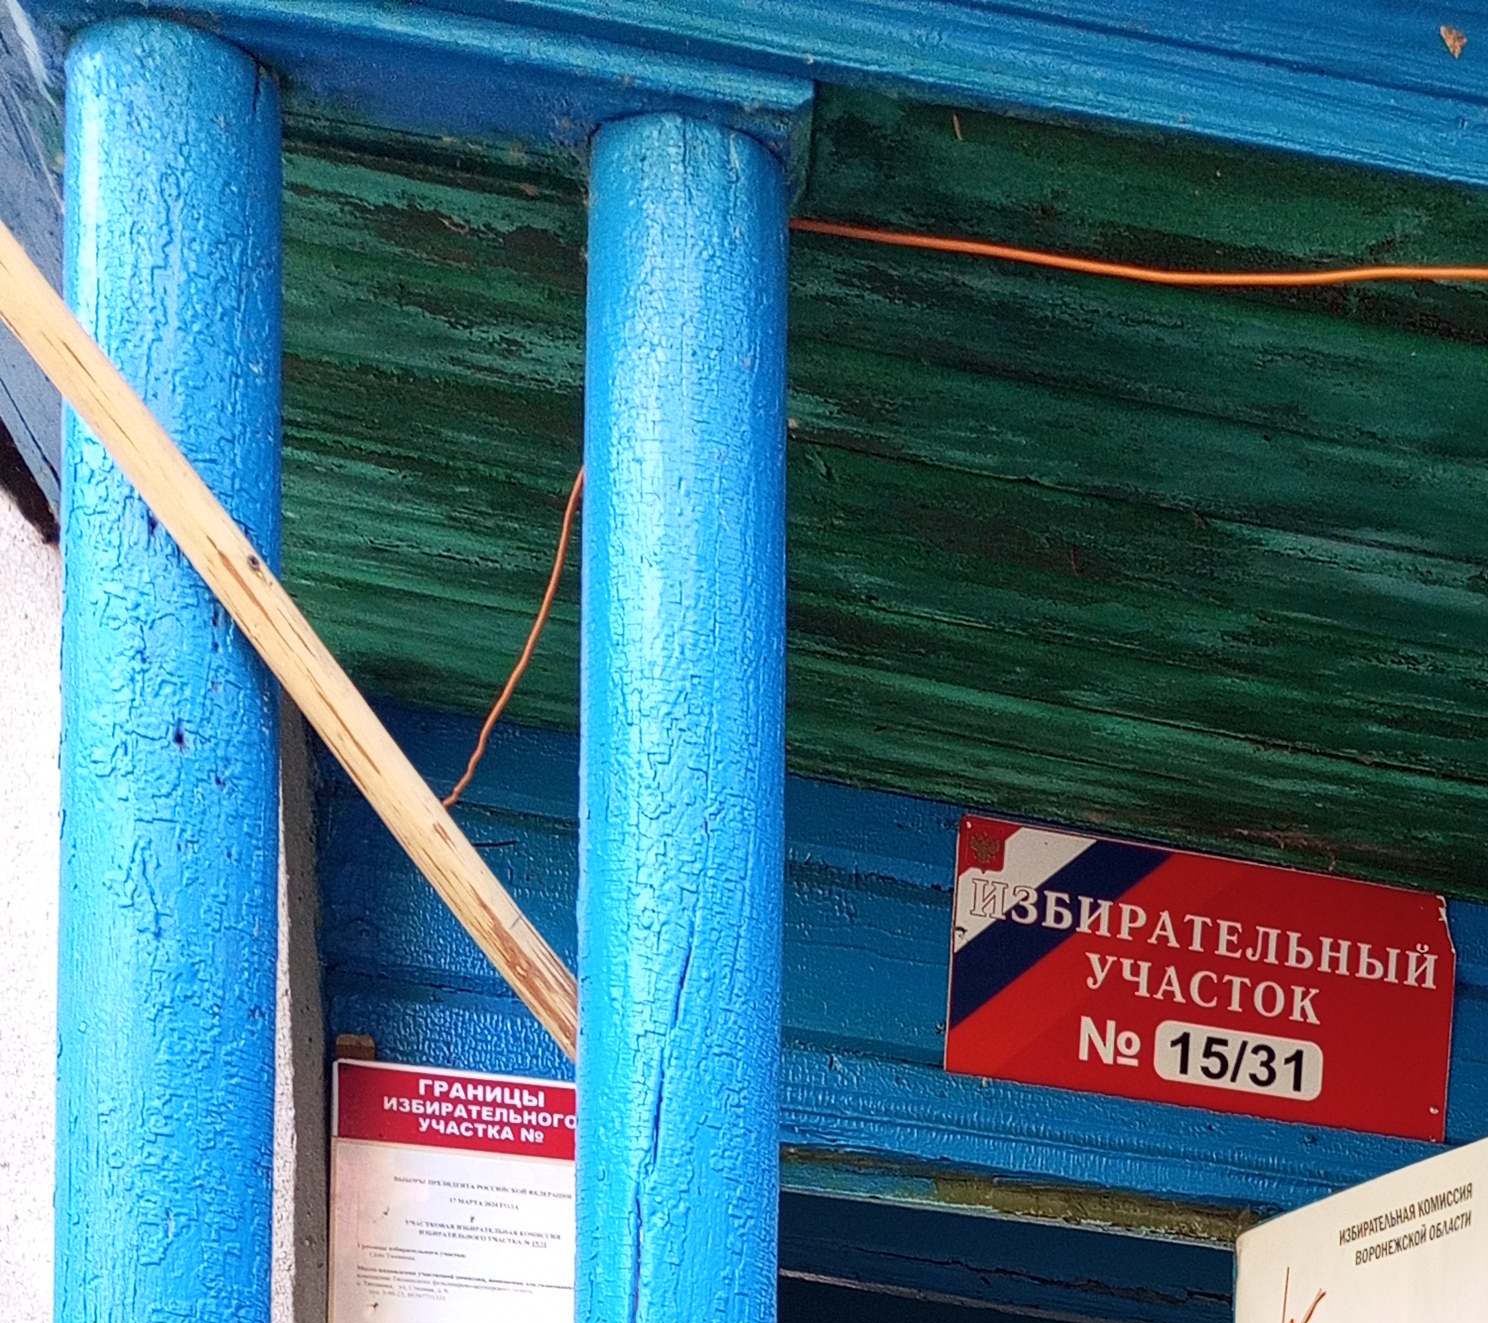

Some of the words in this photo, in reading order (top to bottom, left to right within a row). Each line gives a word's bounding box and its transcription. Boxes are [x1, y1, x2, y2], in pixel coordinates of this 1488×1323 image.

[969, 878, 1438, 989] ИЗБИРАТЕЛЬНЫЙ
[1086, 953, 1321, 1025] УЧАСТОК
[1078, 1016, 1141, 1067] №
[1169, 1031, 1303, 1092] 15/31
[383, 1096, 577, 1129] ИЗБИРАТЕЛЬНОГО
[418, 1079, 545, 1108] ГРАНИЦЫ
[418, 1117, 514, 1141] УЧАСТКА
[520, 1129, 544, 1143] №
[1339, 1203, 1416, 1246] ИЗБИРАТЕЛЬНАЯ
[1418, 1182, 1473, 1218] КОМИССИЯ
[1355, 1224, 1426, 1265] ВОРОНЕЖСКОЙ
[1429, 1210, 1472, 1241] ОБЛАСТИ
